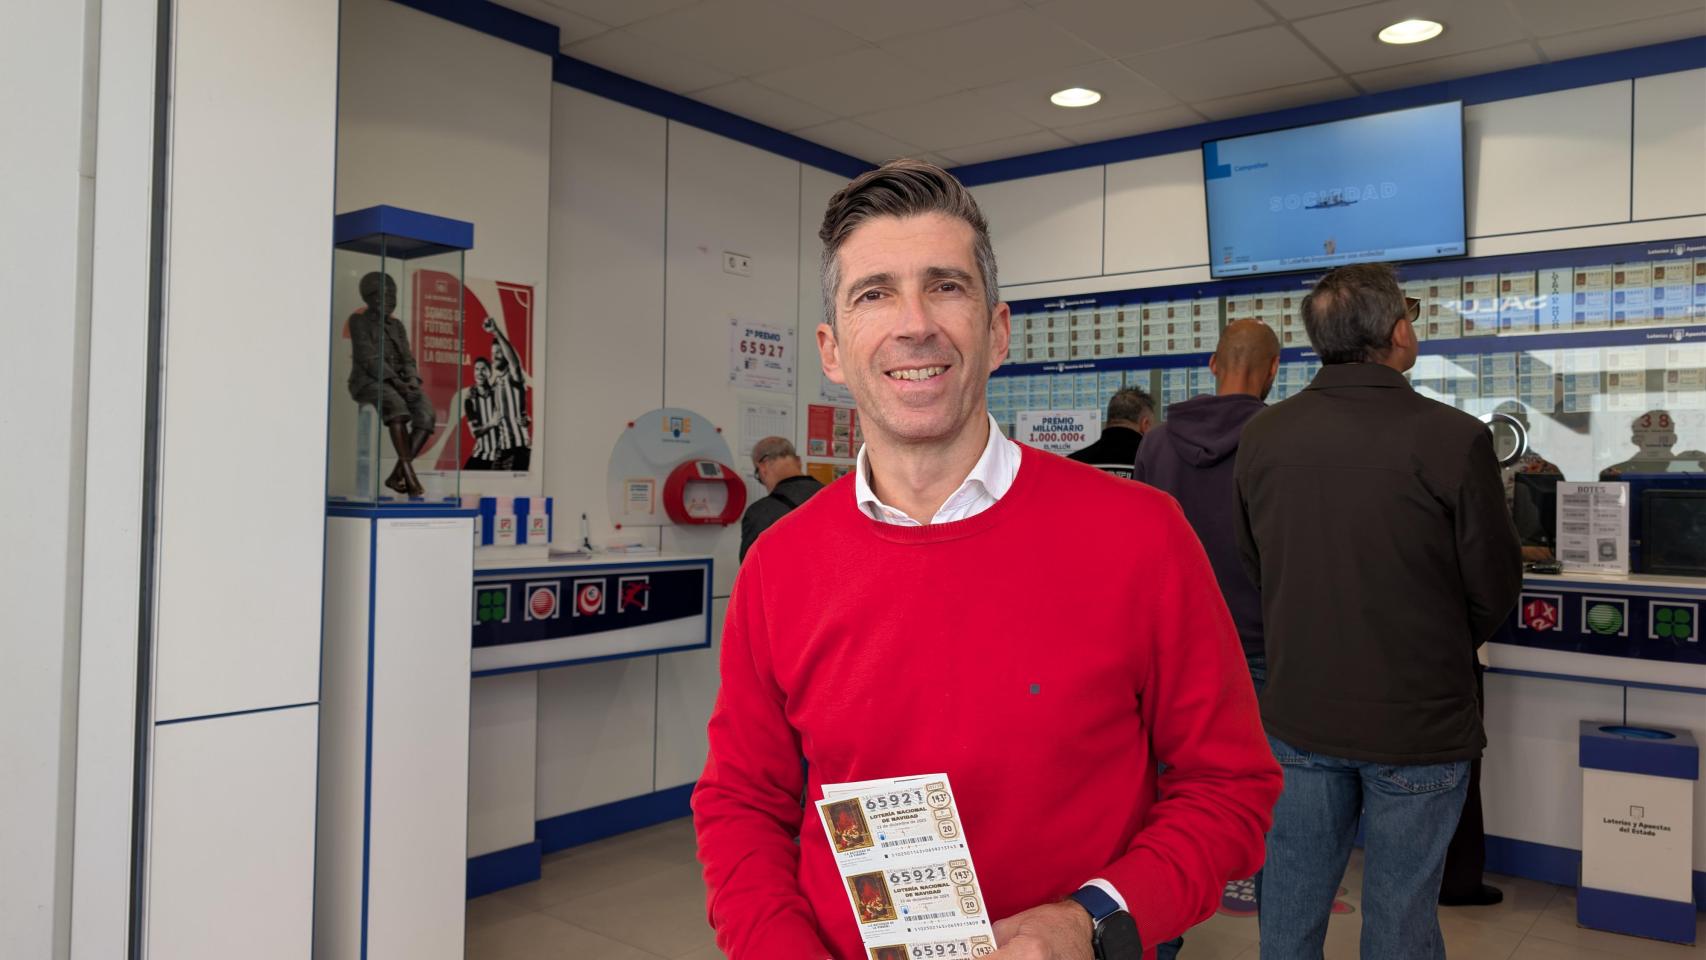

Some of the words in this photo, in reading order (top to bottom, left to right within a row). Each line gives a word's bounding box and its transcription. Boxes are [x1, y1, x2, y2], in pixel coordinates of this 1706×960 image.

[1270, 182, 1398, 212] SOCIEDAD
[755, 330, 781, 342] PREMIO
[740, 340, 784, 358] 65927
[1042, 417, 1074, 425] PREMIO
[1032, 424, 1084, 432] MILLONARIO
[866, 790, 923, 810] 65921
[869, 809, 896, 820] LOTERÍA
[896, 807, 928, 816] NACIONAL
[891, 814, 919, 823] NAVIDAD
[942, 825, 952, 833] 20
[1638, 822, 1671, 832] Apuestas
[1631, 828, 1656, 837] Estado
[889, 867, 946, 883] 65921
[893, 885, 919, 893] LOTERÍA
[920, 882, 951, 890] NACIONAL
[914, 889, 942, 897] NAVIDAD
[965, 901, 975, 909] 20
[912, 942, 968, 957] 65921
